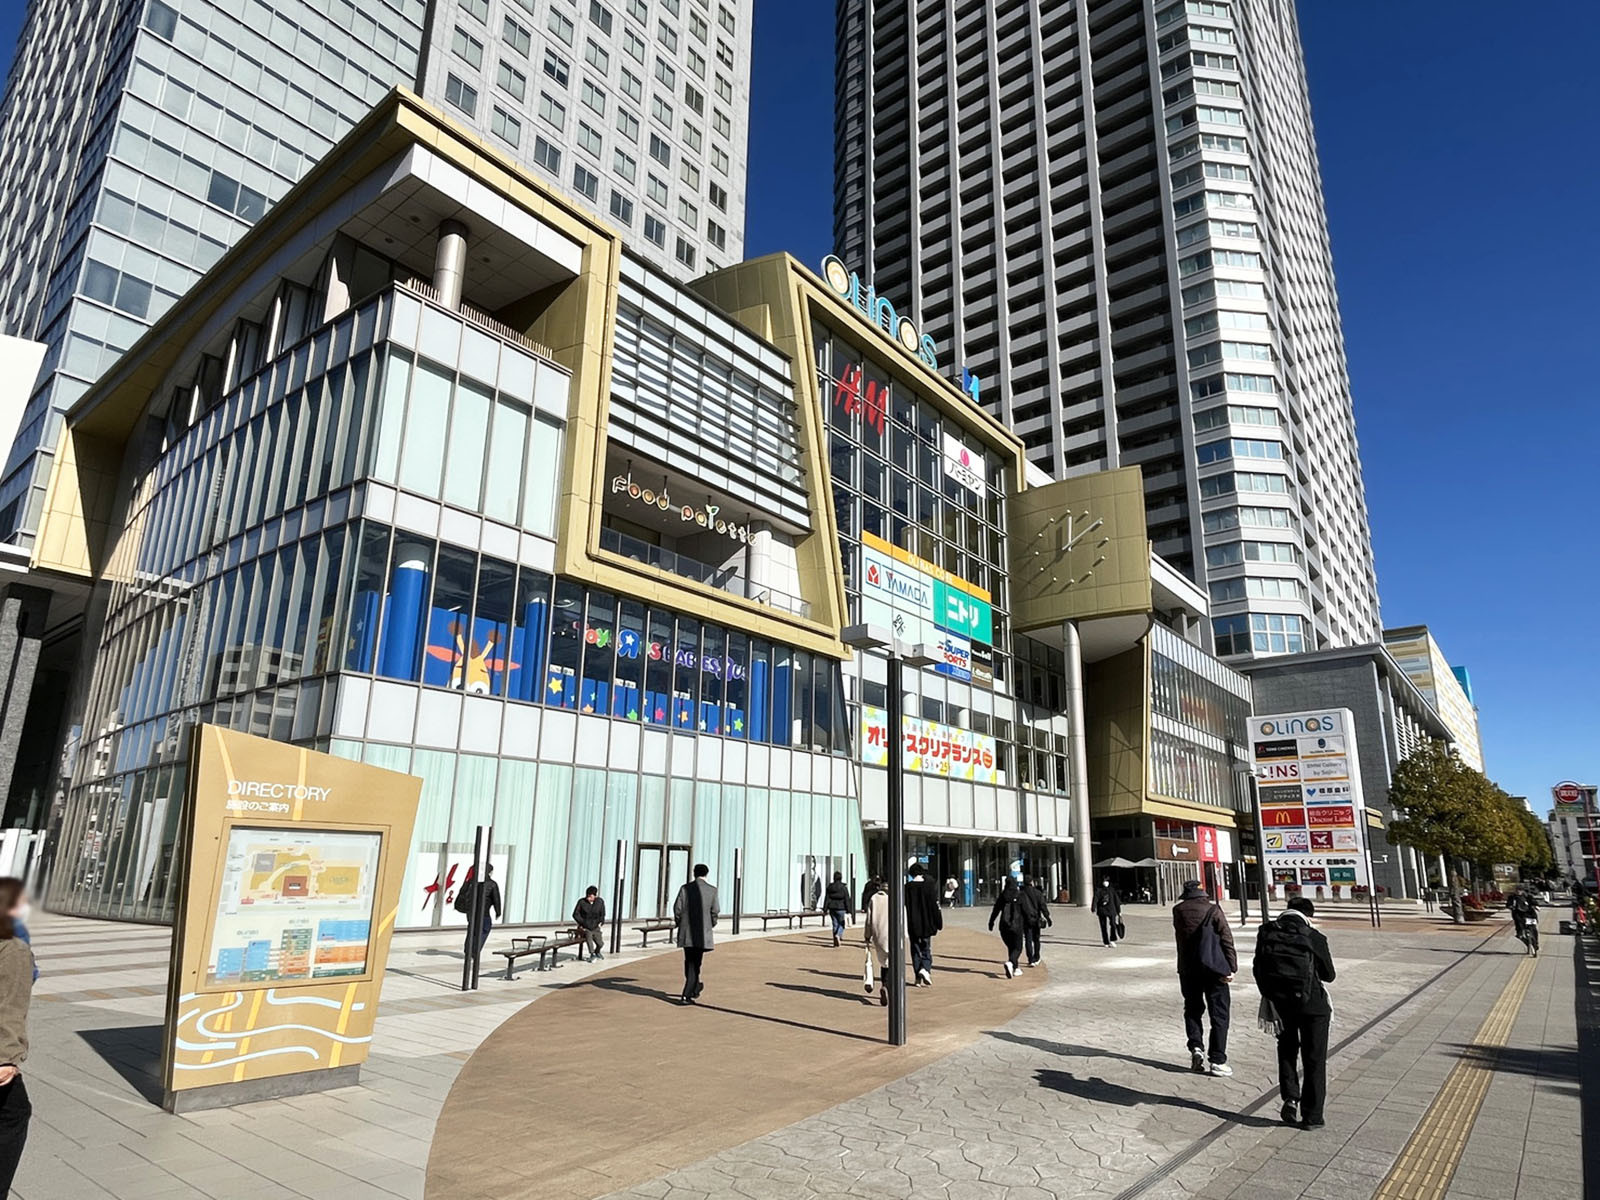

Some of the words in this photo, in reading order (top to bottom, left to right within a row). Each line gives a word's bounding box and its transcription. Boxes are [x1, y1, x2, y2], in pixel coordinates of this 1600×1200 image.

[834, 363, 888, 436] H&M
[885, 570, 928, 605] YAMADA
[948, 596, 979, 628] ニトリ
[944, 640, 970, 660] SUPER
[868, 726, 982, 766] オリスクリアランス
[227, 779, 331, 801] DIRECTORY
